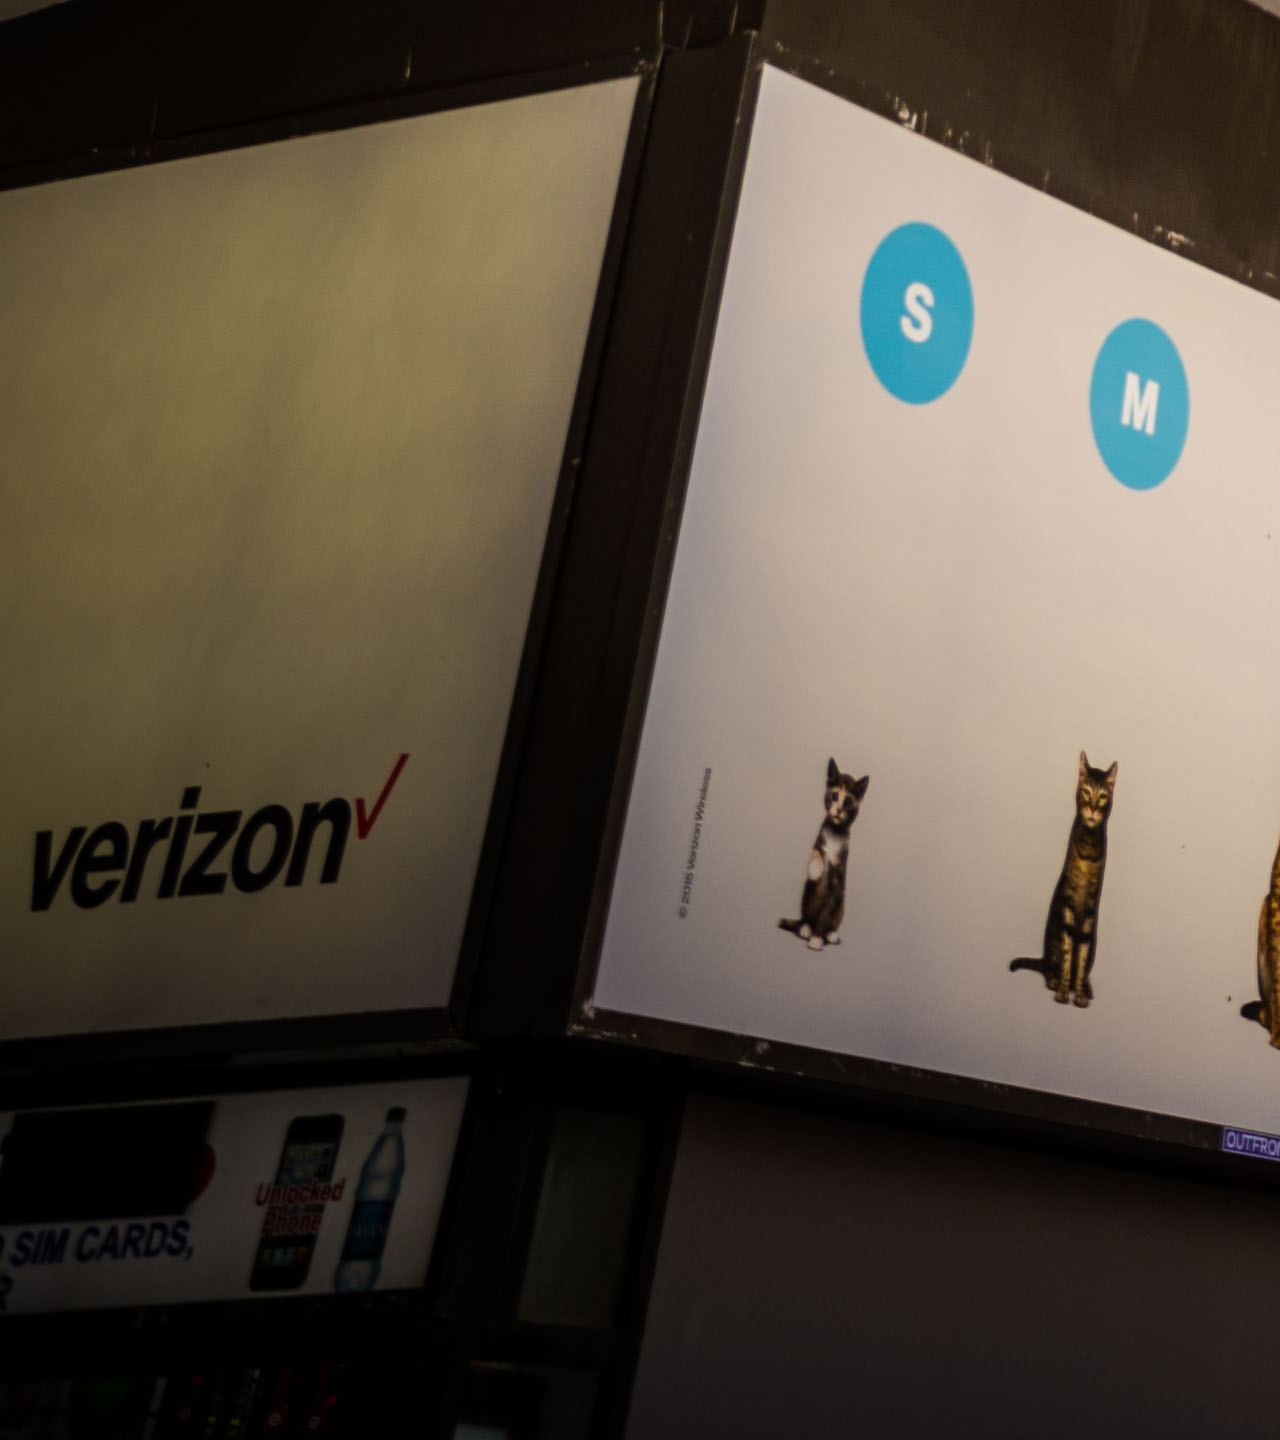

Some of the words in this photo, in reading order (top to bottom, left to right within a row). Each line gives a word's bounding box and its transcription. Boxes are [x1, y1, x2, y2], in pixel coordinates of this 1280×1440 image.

[901, 283, 934, 342] S
[1121, 372, 1159, 435] M
[30, 785, 352, 913] verizon
[680, 872, 694, 905] 2015
[255, 1178, 346, 1206] Unlocked
[10, 1227, 71, 1267] SIM
[76, 1220, 194, 1263] CARDS,
[262, 1210, 323, 1233] Phone
